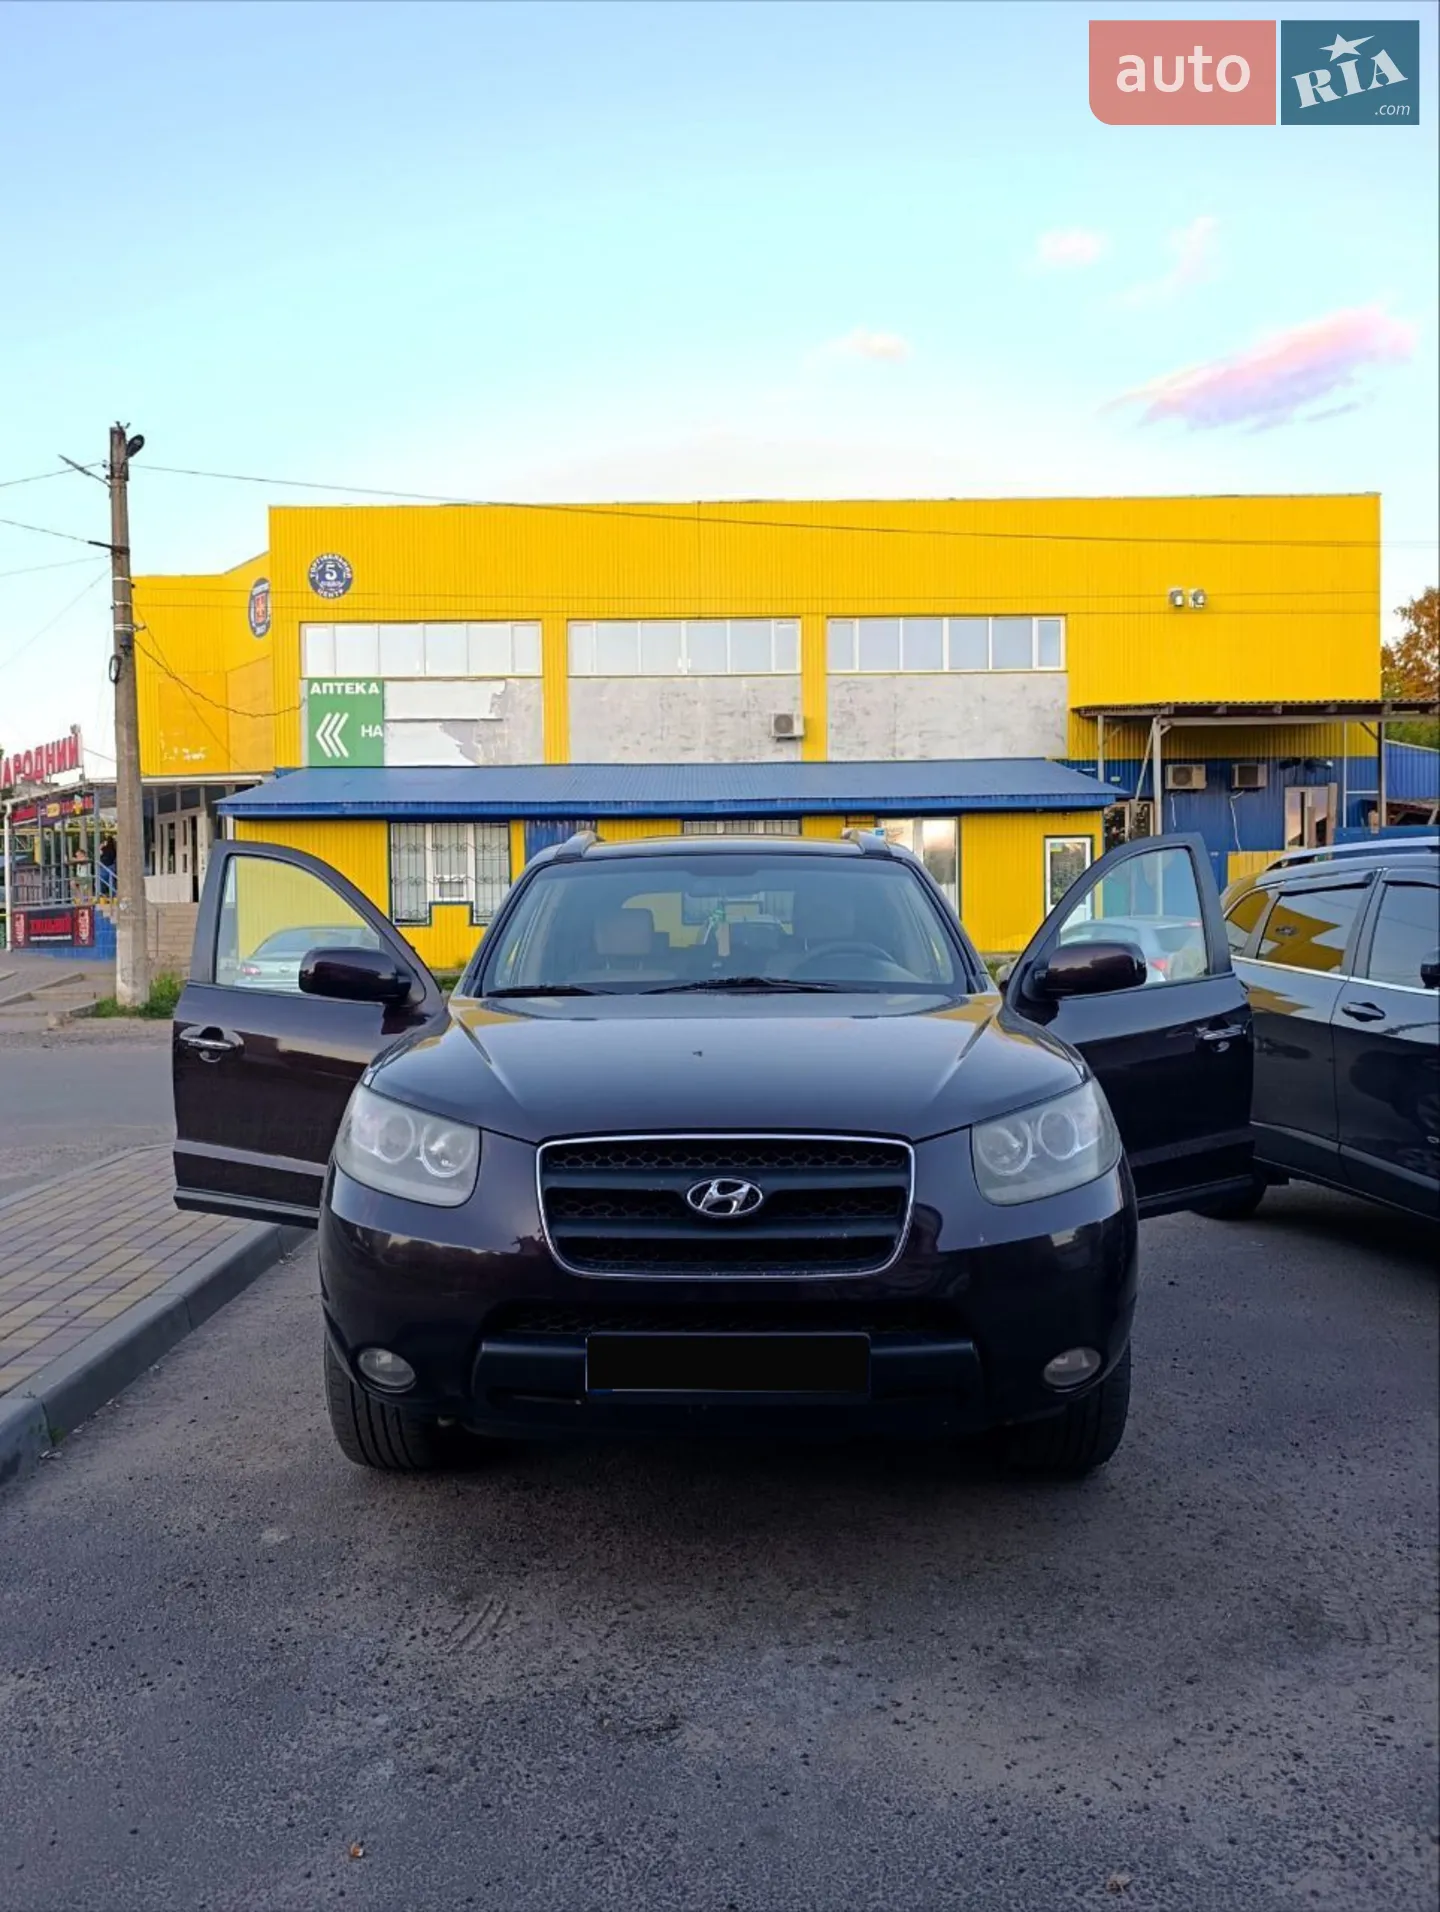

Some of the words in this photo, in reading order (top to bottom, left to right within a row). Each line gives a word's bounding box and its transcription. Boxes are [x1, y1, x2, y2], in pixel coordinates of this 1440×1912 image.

[325, 564, 337, 581] 5
[310, 682, 380, 695] АПТЕКА
[361, 724, 383, 738] НА
[0, 726, 80, 790] АРОДНИЙ
